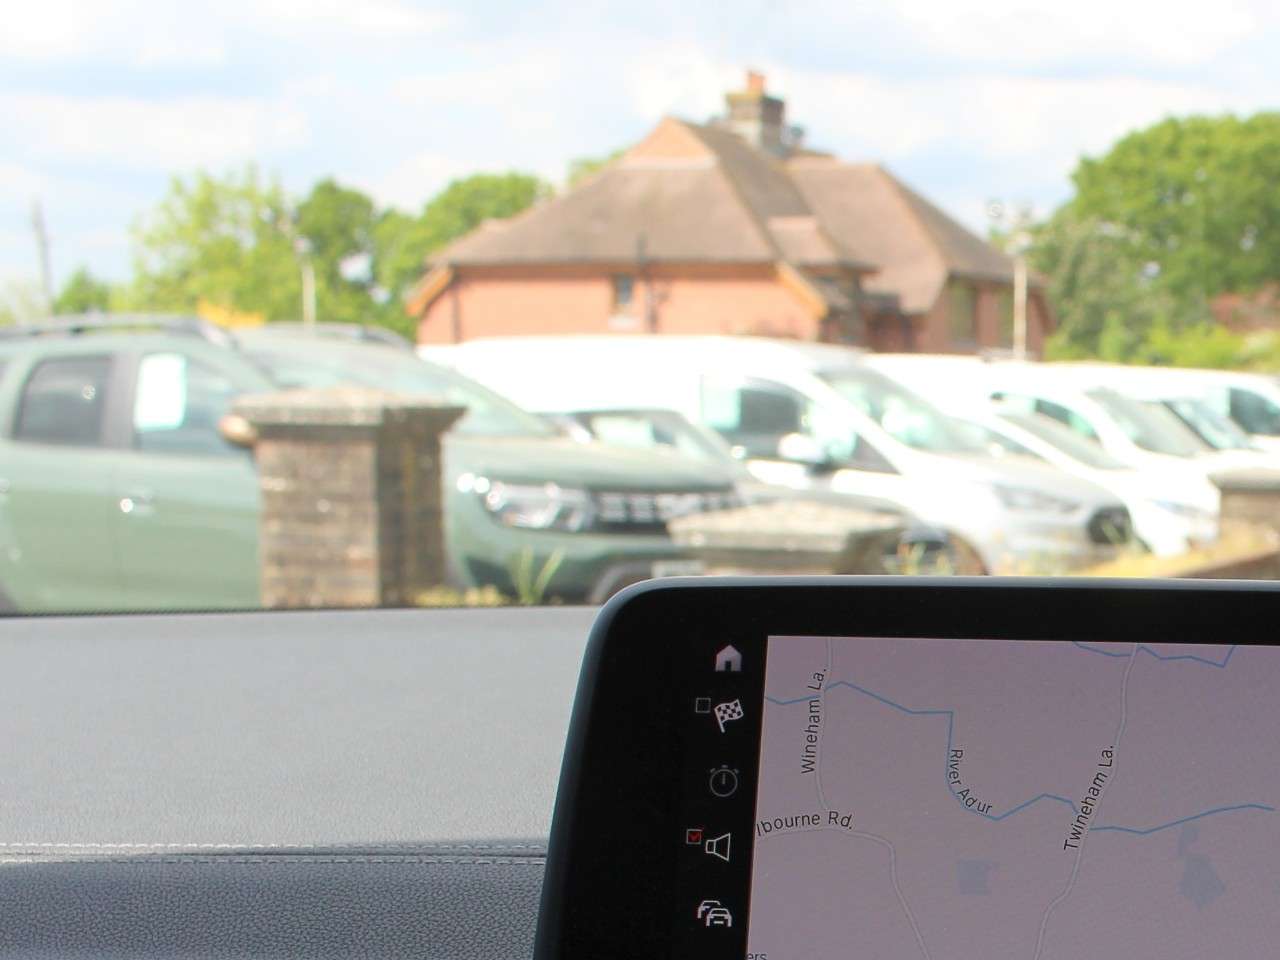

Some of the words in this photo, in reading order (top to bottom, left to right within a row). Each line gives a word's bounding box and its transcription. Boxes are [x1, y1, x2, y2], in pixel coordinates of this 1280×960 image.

[808, 668, 826, 691] La.
[801, 699, 820, 774] Wineham
[948, 749, 963, 786] River
[956, 787, 992, 814] Adur
[1063, 770, 1108, 851] Twineham
[1100, 745, 1114, 768] La.
[828, 810, 853, 830] Rd.
